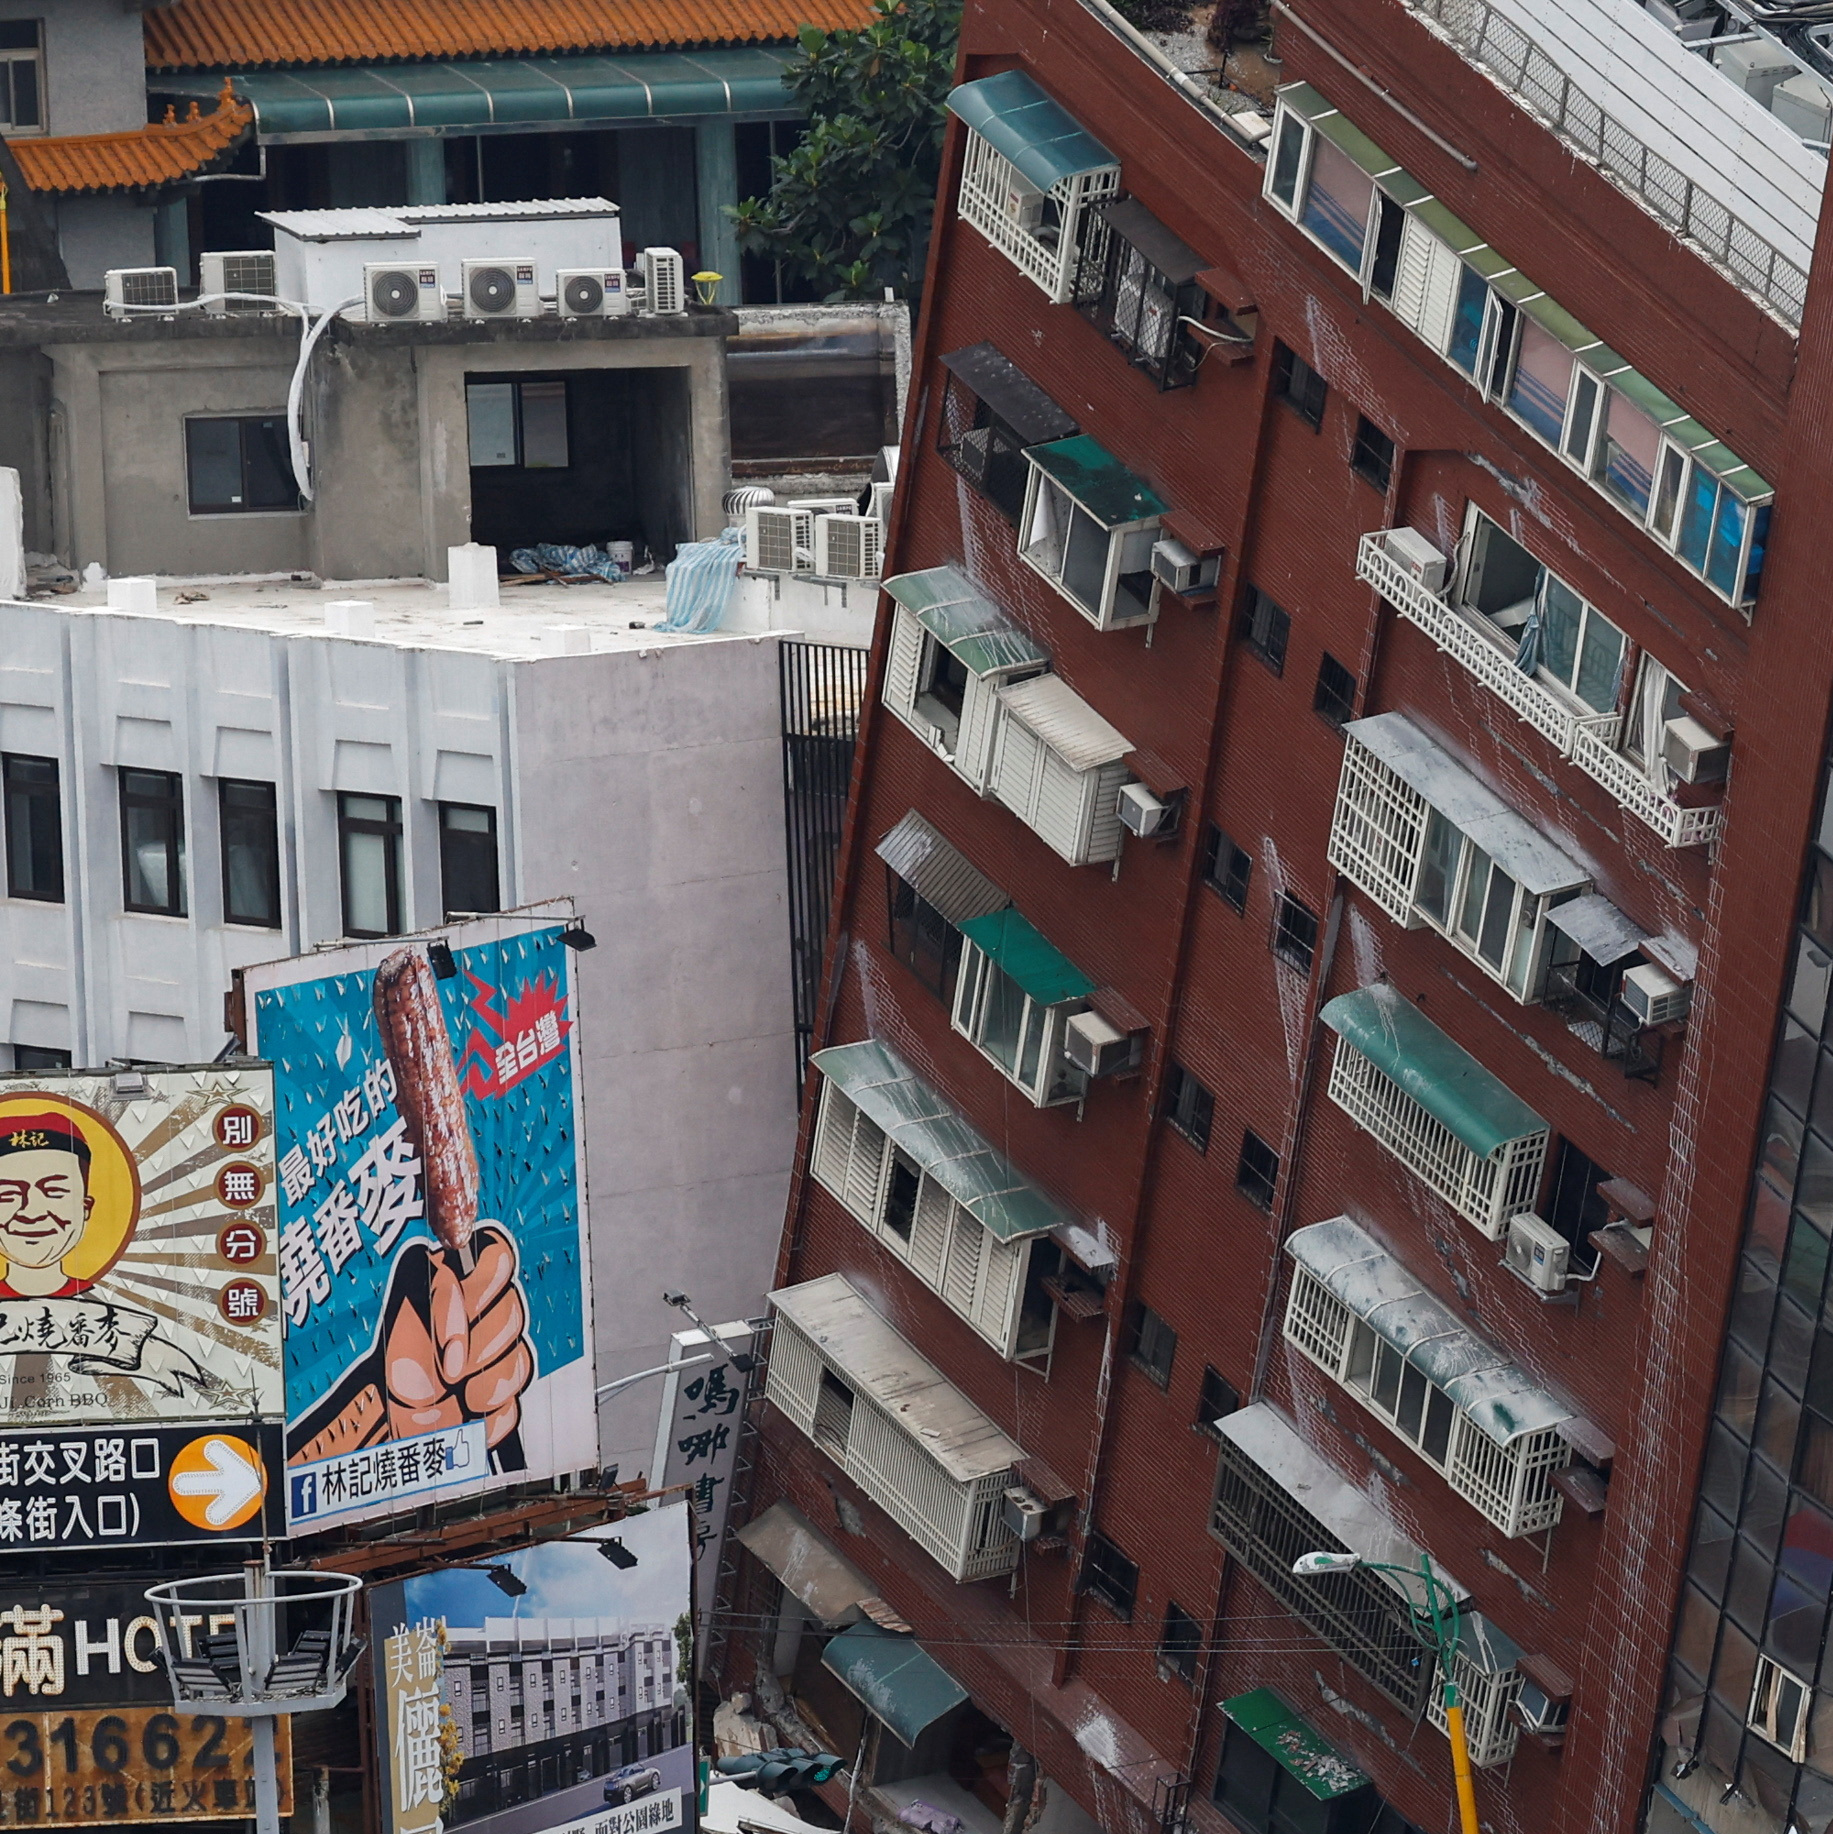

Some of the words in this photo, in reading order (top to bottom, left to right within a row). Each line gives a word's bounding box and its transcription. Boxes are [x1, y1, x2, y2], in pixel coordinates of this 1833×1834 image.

[494, 1010, 560, 1085] 全台灣
[9, 1130, 50, 1149] 林記
[279, 1058, 398, 1204] 最好吃的
[222, 1114, 260, 1319] 別無分號
[39, 1372, 72, 1384] 1965
[69, 1390, 108, 1408] BBQ
[321, 1432, 447, 1506] 林記燒番麥
